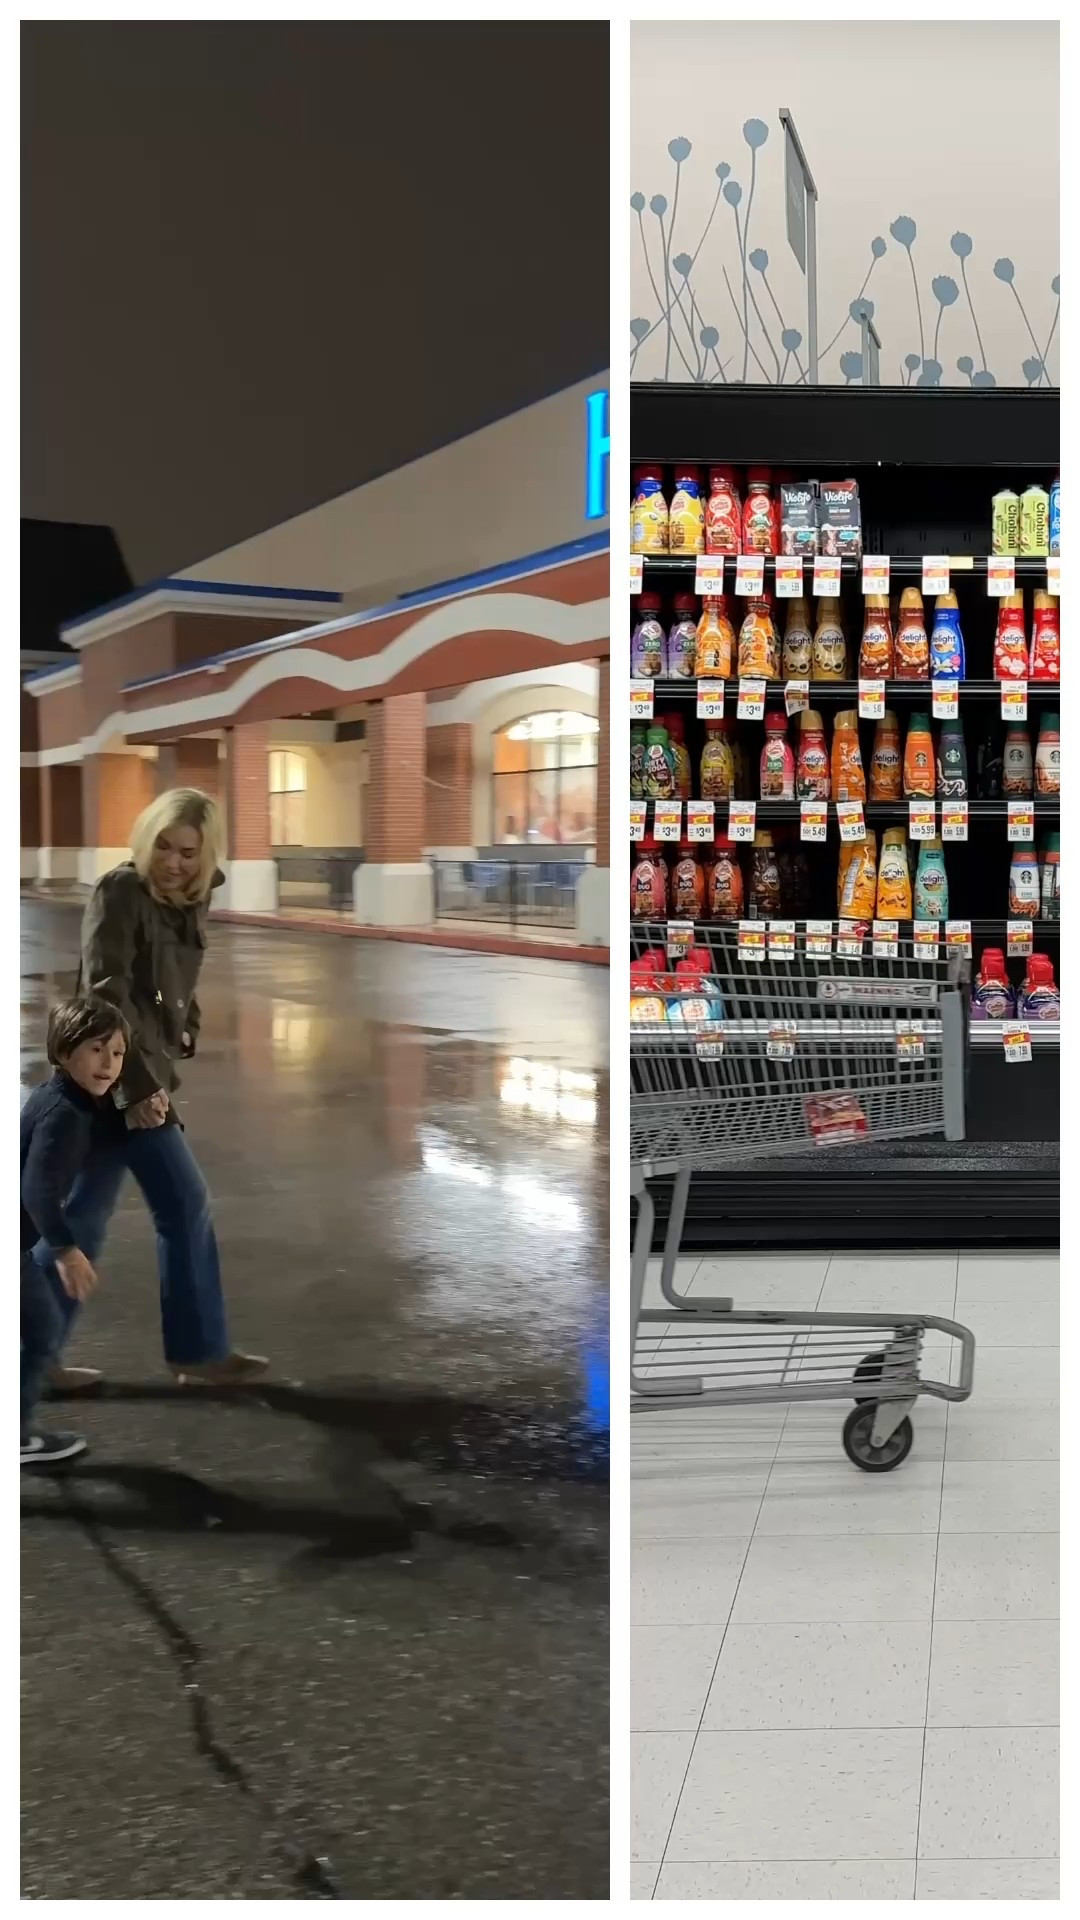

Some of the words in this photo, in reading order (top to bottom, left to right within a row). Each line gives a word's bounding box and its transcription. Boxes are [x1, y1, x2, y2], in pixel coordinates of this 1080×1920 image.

[785, 491, 812, 505] Violife
[824, 491, 853, 504] Violife
[1008, 504, 1018, 549] Chobani
[1036, 502, 1046, 547] Chobani
[786, 637, 811, 646] delight
[874, 754, 899, 763] delight
[812, 826, 826, 836] 5.49
[920, 875, 945, 885] delight
